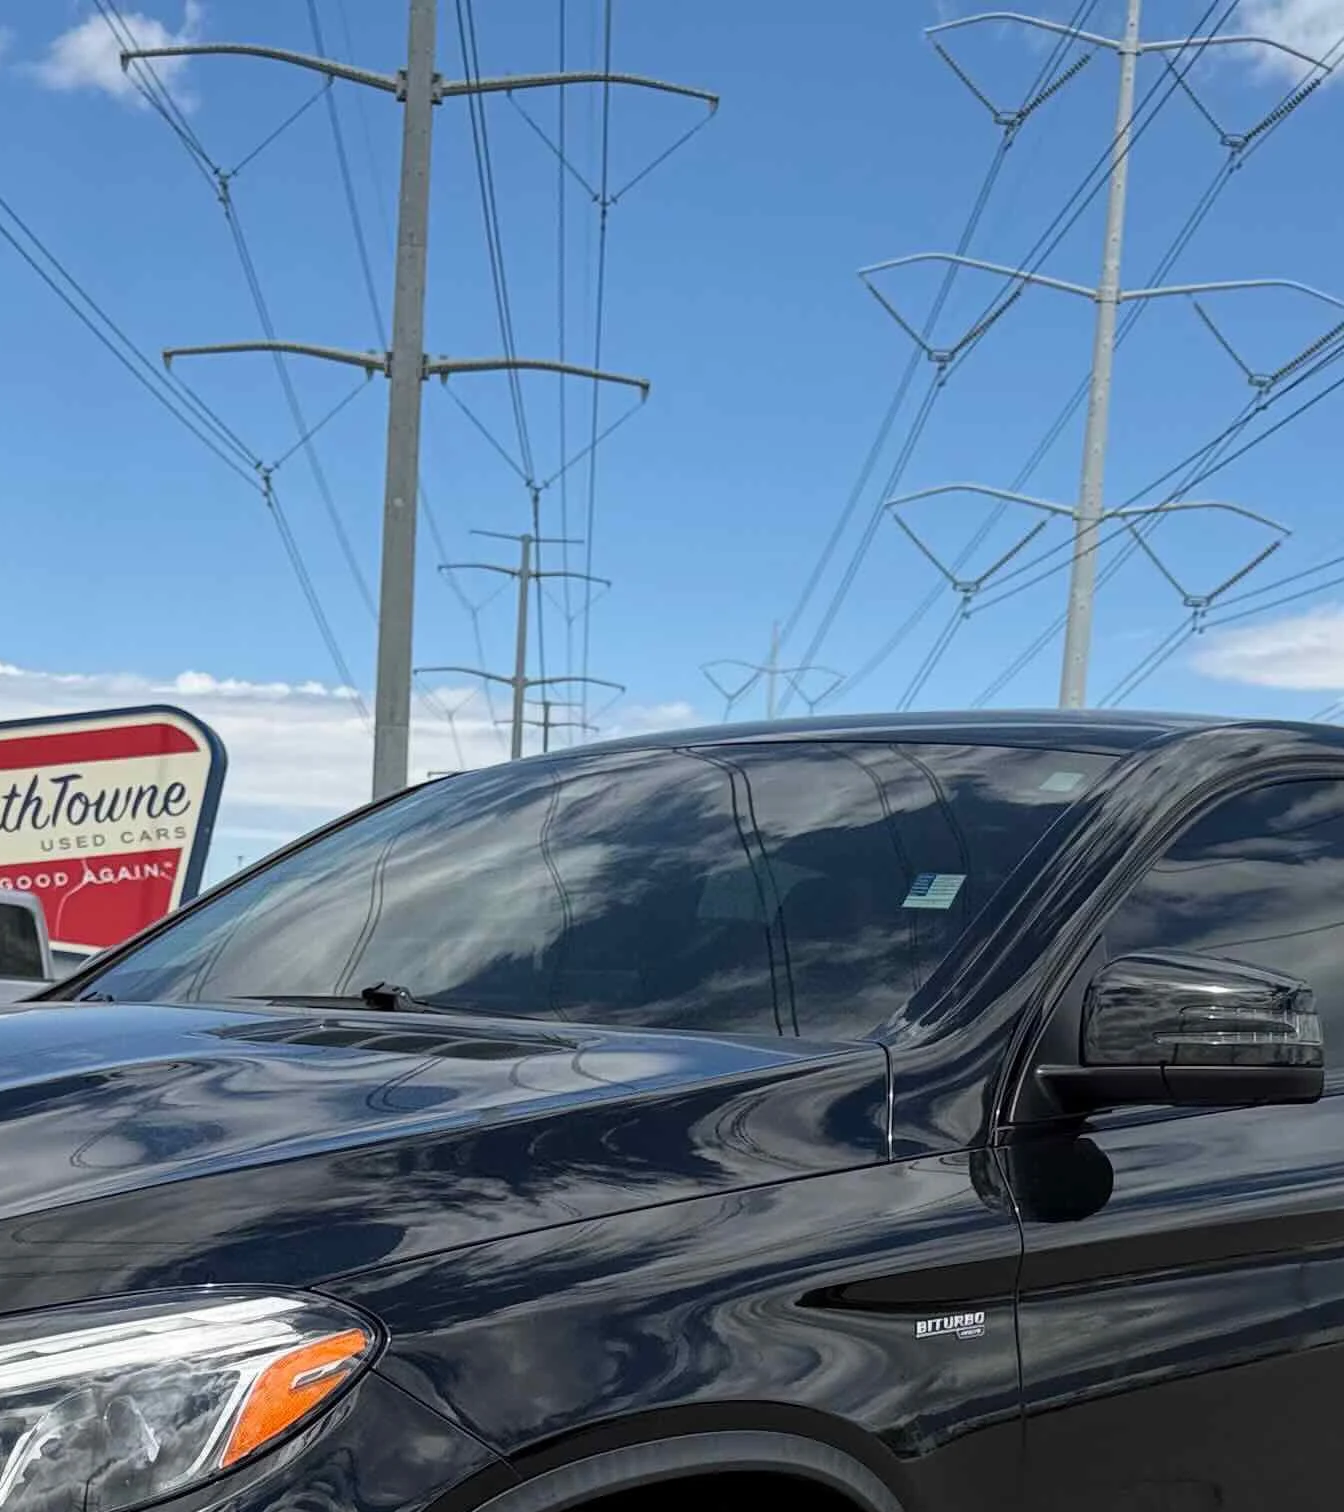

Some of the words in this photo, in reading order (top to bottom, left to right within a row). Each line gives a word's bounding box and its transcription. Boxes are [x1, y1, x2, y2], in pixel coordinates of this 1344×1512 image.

[40, 833, 107, 852] USED
[119, 826, 188, 845] CARS
[916, 1311, 985, 1334] BITURBO
